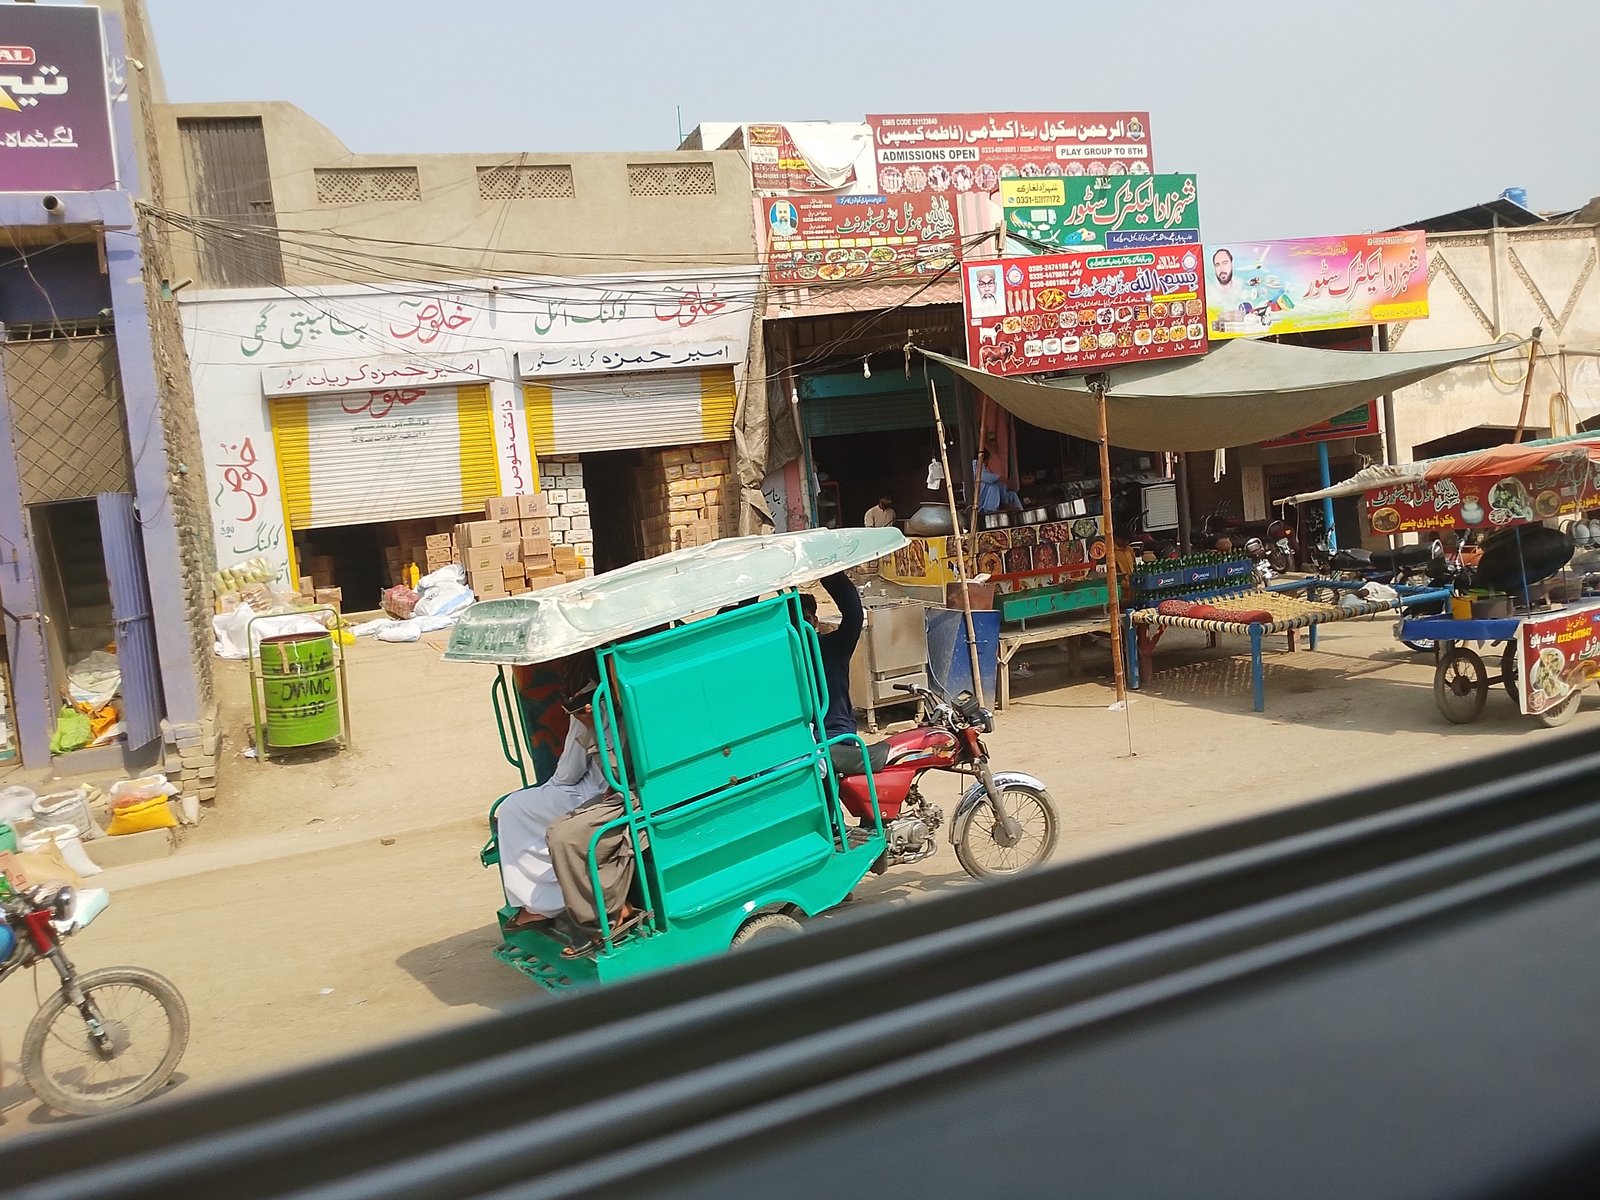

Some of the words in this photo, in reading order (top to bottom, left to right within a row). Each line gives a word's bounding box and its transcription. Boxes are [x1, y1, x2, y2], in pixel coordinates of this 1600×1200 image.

[965, 116, 1019, 143] اکیڈمی
[1039, 119, 1077, 142] سکول
[1078, 119, 1124, 142] الرحمن
[882, 150, 945, 161] ADMISSIONS
[948, 149, 976, 160] OPEN
[1061, 148, 1086, 156] PLAY
[1088, 148, 1113, 156] GROUP
[1127, 147, 1143, 155] 8TH
[1064, 185, 1107, 225] سٹور
[1303, 259, 1341, 299] سٹور
[572, 290, 633, 324] کوکنگ
[241, 302, 277, 357] گھی
[281, 308, 368, 350] بناسپتی
[528, 352, 568, 372] سٹور
[570, 350, 598, 371] کریانہ
[602, 349, 671, 370] حمزہ
[671, 345, 729, 364] امیر
[306, 364, 370, 387] کریانہ
[371, 366, 429, 385] حمزہ
[427, 359, 480, 380] امیر
[501, 400, 515, 442] ذائقہ
[506, 443, 524, 489] خلوص
[1400, 517, 1417, 531] چنے
[1417, 515, 1440, 529] لاہوری
[1440, 514, 1456, 528] چکن
[233, 521, 284, 554] کوکنگ
[275, 559, 290, 585] آئ
[1541, 631, 1557, 645] بیف
